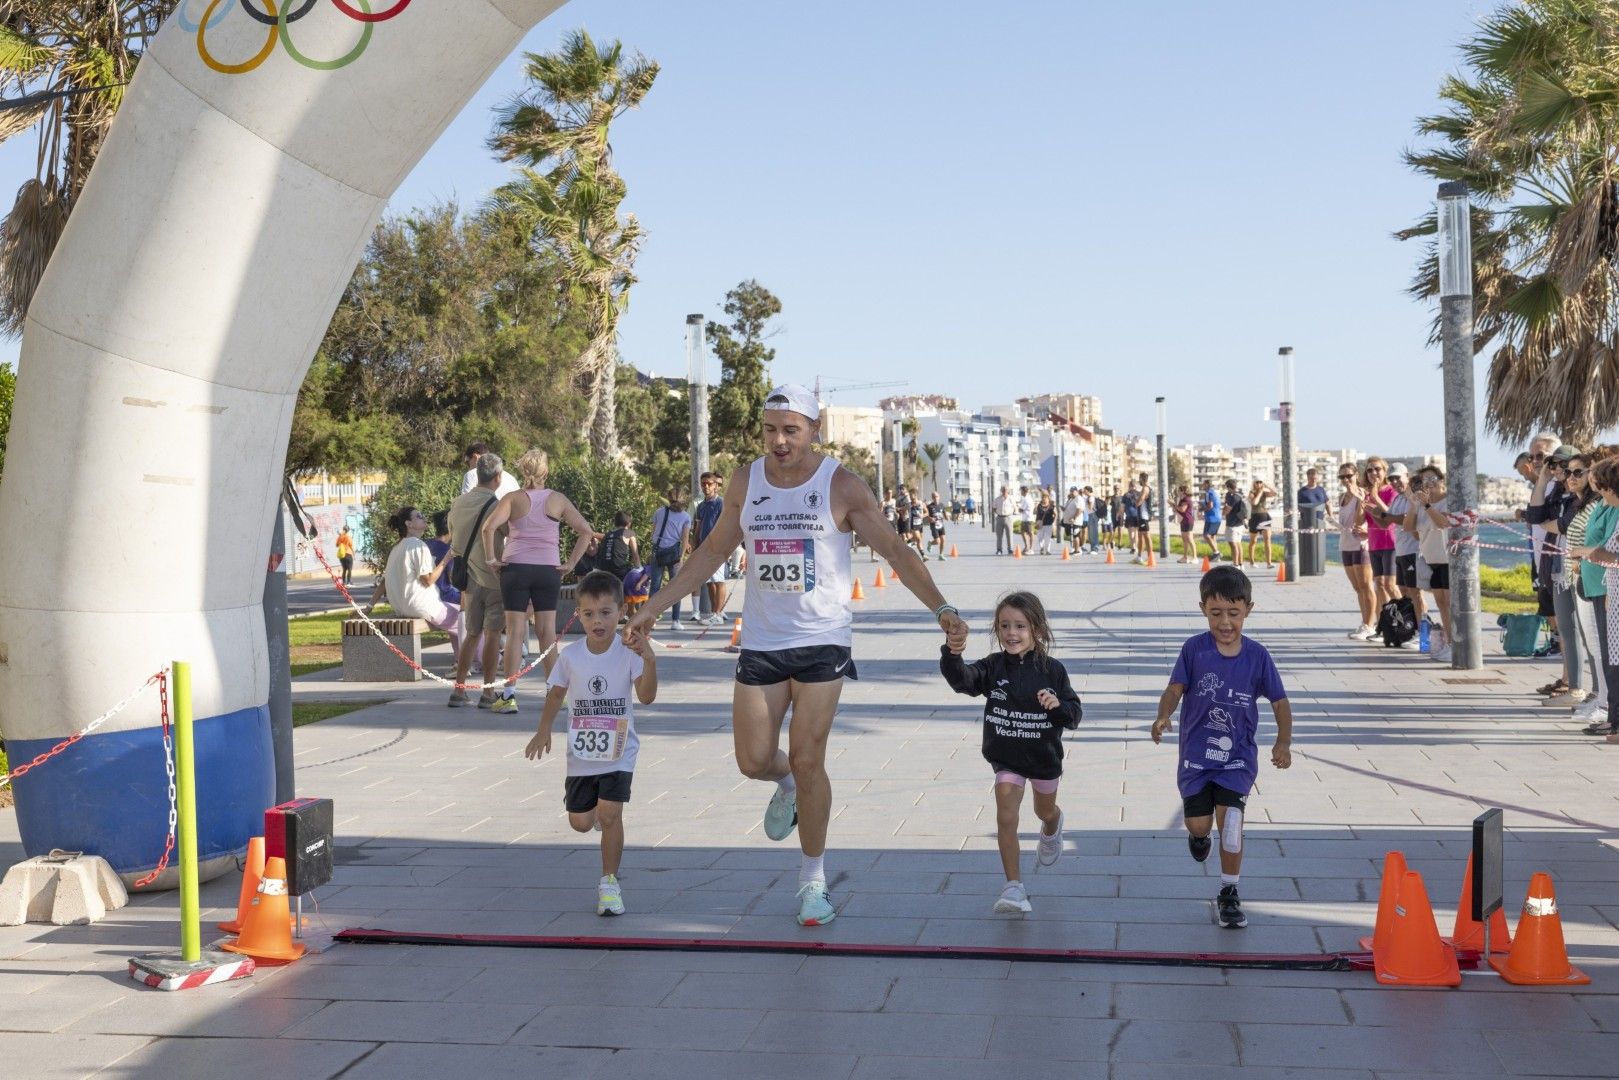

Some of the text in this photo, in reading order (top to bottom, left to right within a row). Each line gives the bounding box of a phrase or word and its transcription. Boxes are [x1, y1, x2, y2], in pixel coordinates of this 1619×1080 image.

[754, 513, 818, 522] CLUB ATLETISMO
[777, 523, 824, 532] TORREVIEJA
[758, 563, 801, 582] 203
[805, 558, 815, 576] KM
[992, 706, 1048, 720] CLUB ATLETISMO
[985, 714, 1010, 727] PUERTO
[573, 730, 610, 753] 533
